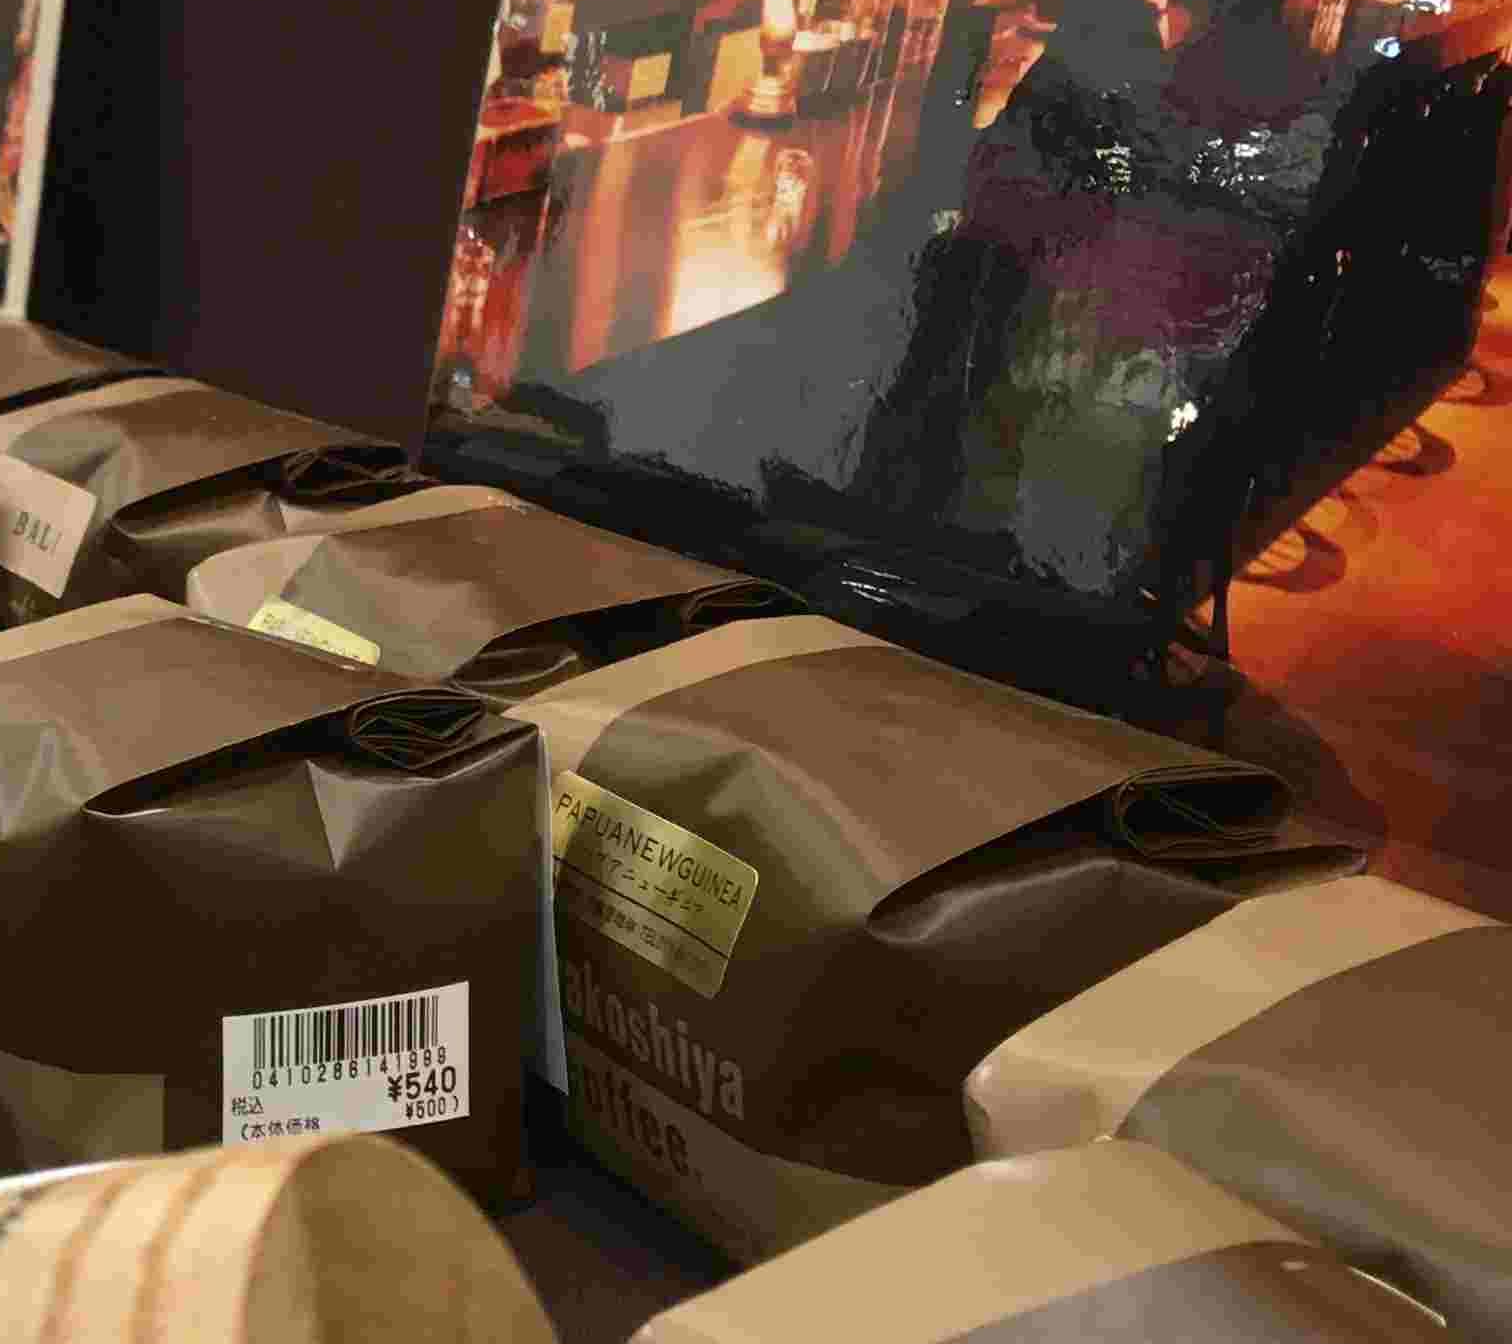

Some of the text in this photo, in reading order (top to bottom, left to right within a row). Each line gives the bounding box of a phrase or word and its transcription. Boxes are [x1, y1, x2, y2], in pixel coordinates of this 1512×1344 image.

[11, 512, 64, 559] BALI
[554, 793, 745, 912] PAPUANEWGUINEA
[231, 1065, 457, 1117] 税込 ¥540
